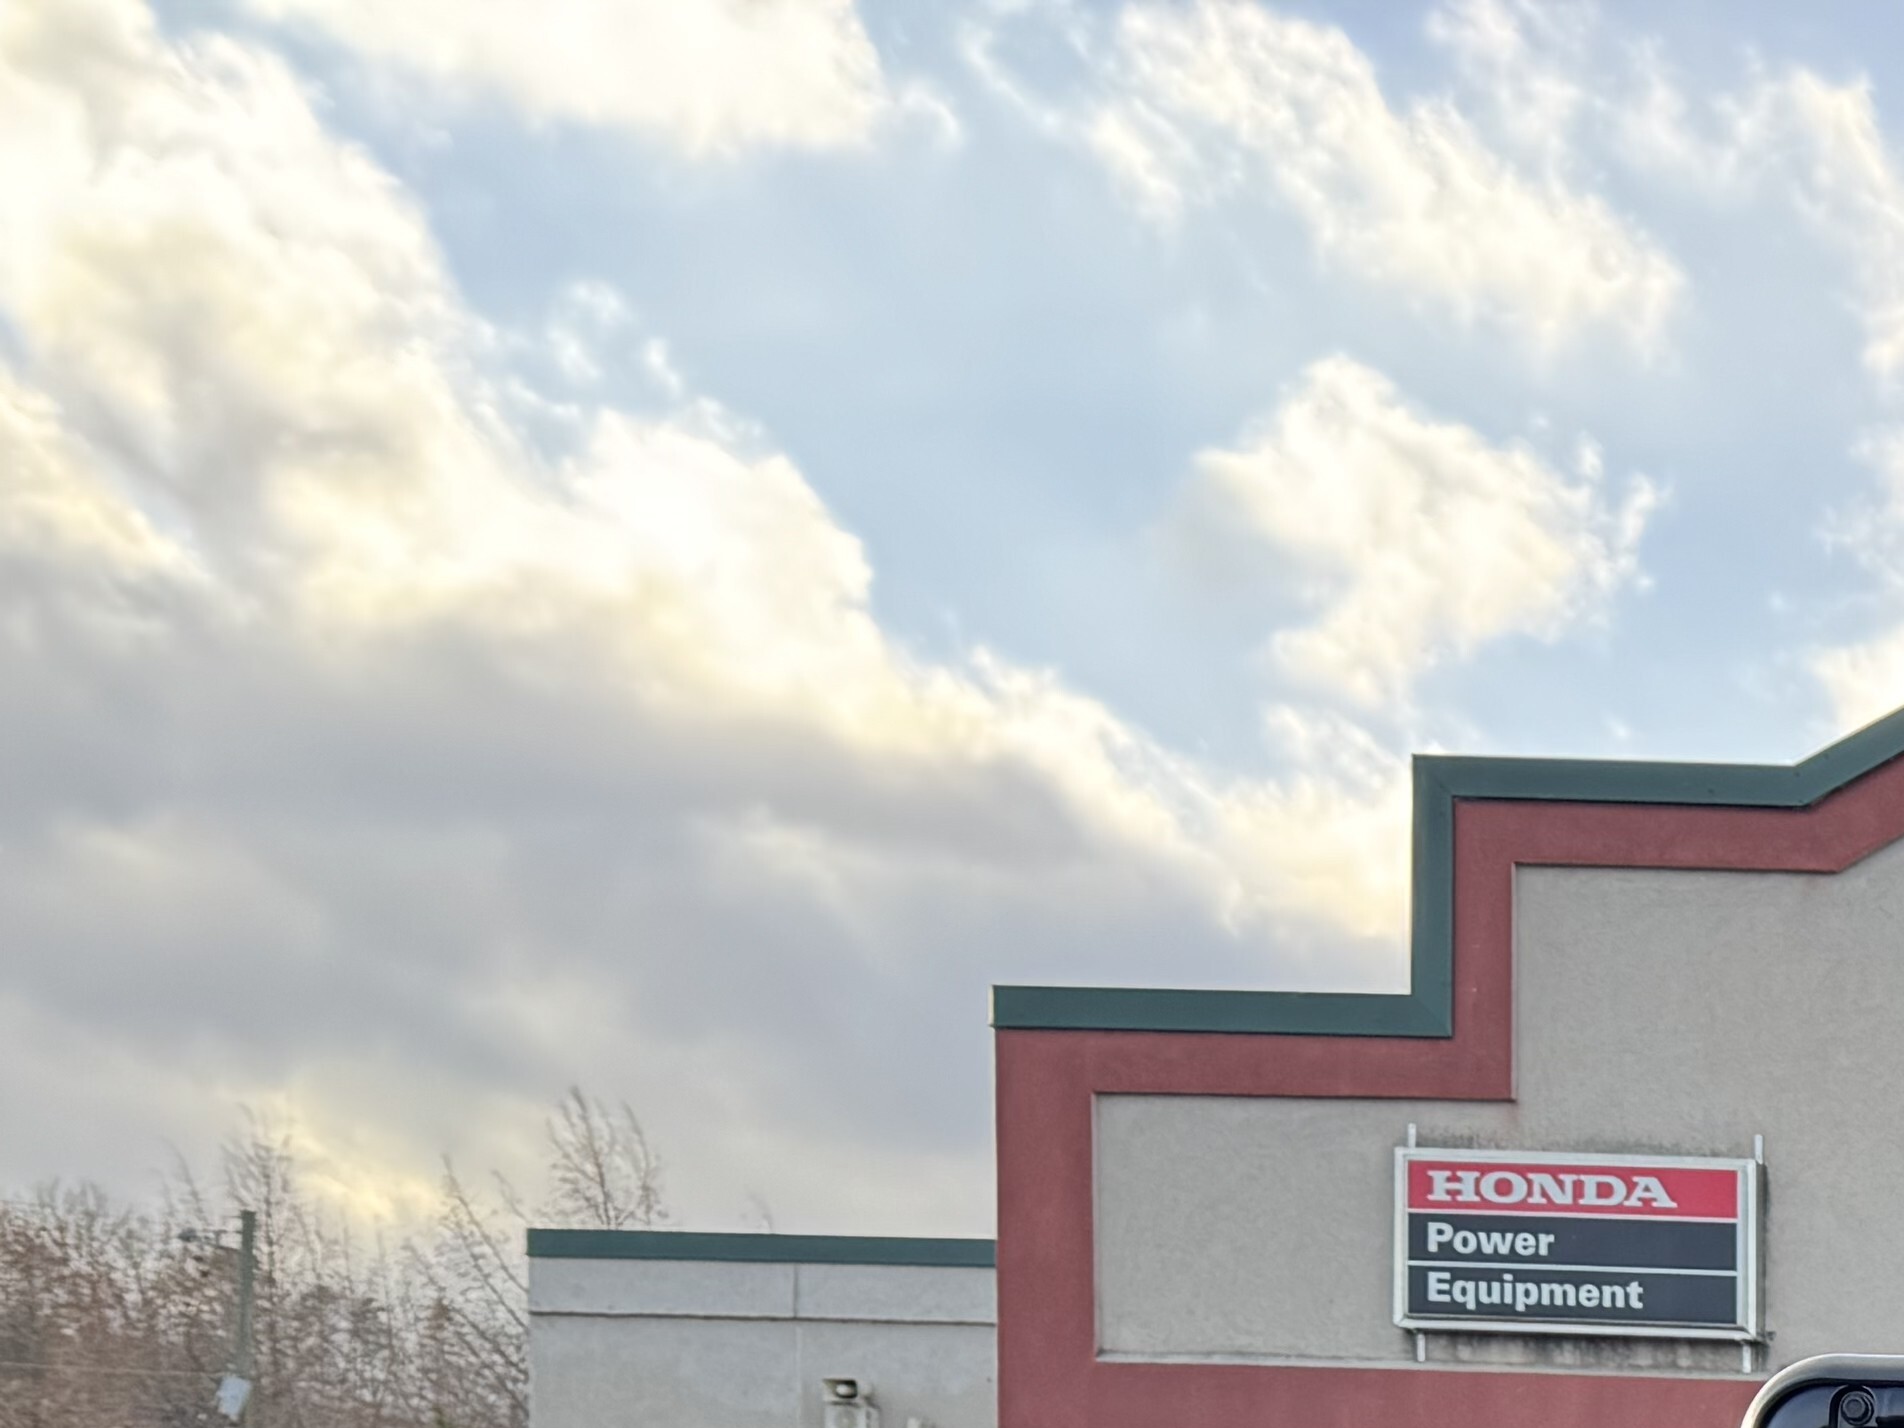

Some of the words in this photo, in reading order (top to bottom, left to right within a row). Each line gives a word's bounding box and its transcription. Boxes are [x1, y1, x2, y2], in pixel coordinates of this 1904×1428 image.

[1427, 1169, 1678, 1209] HONDA
[1427, 1221, 1555, 1257] Power
[1427, 1271, 1644, 1312] Equipment
